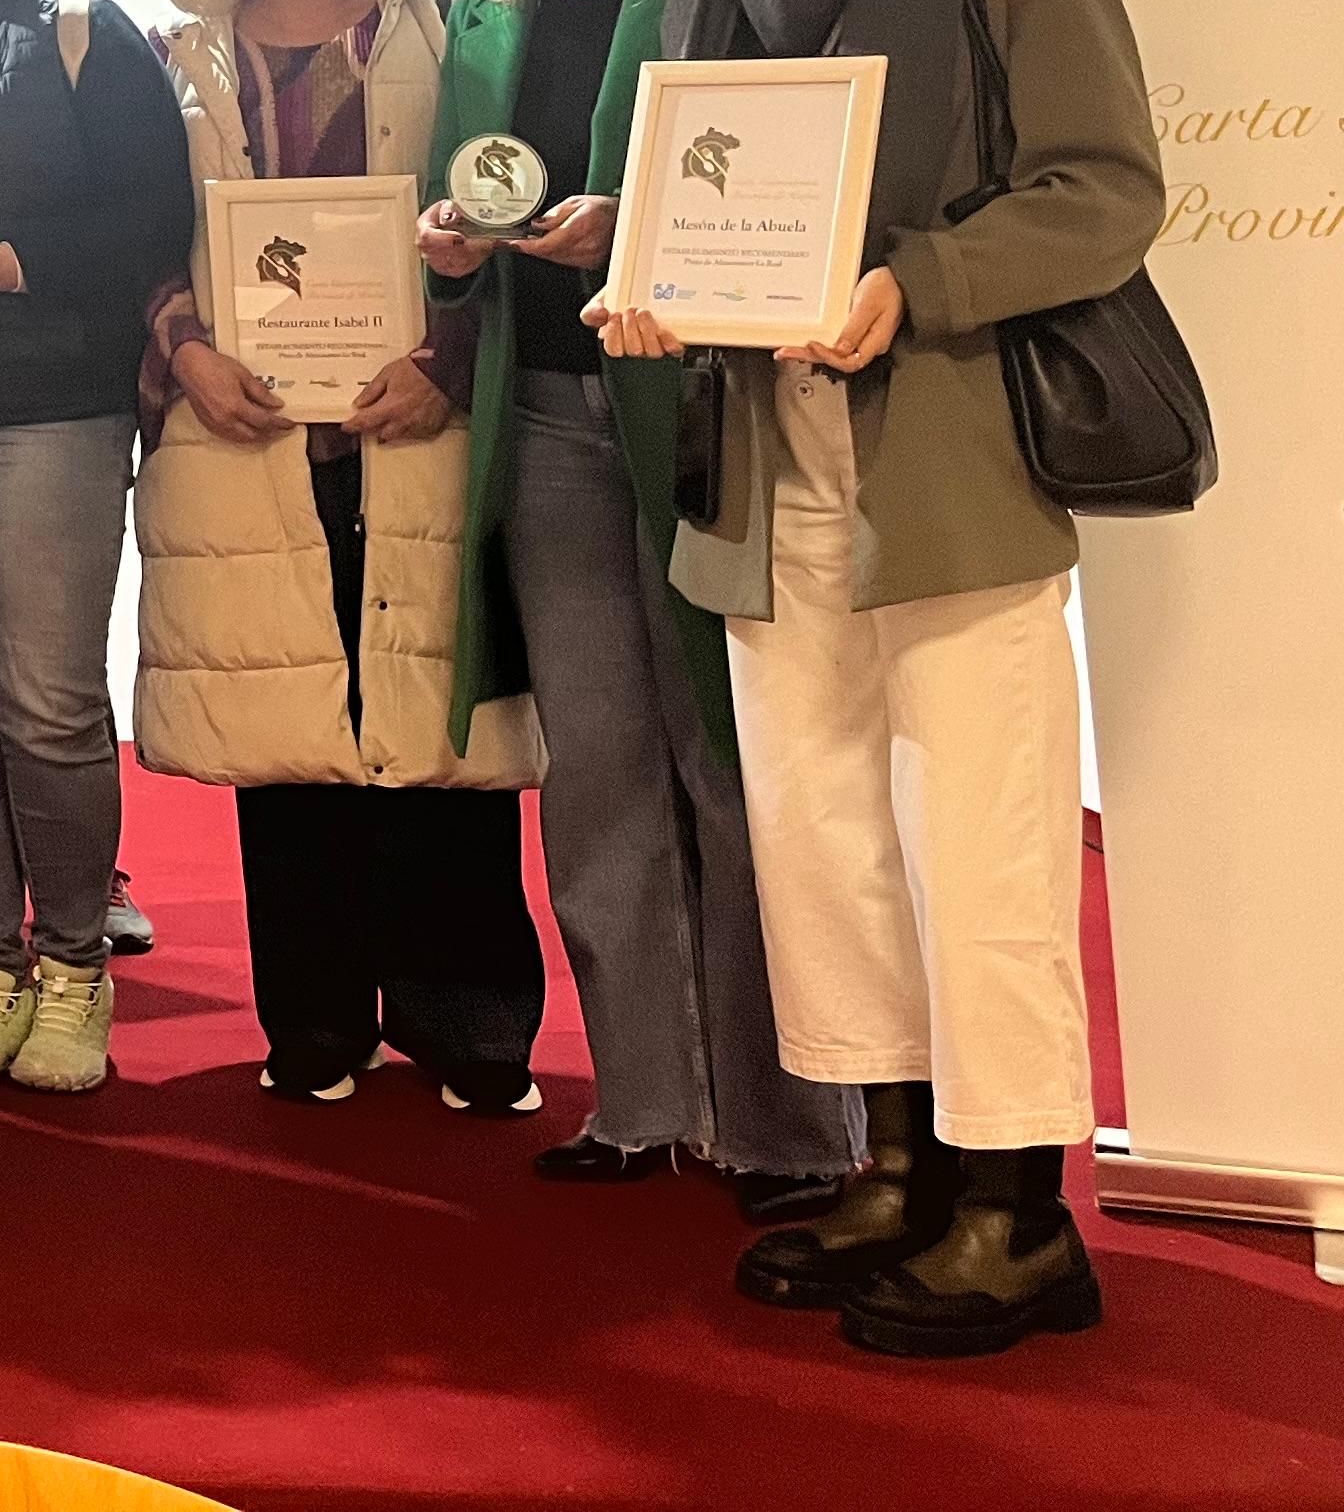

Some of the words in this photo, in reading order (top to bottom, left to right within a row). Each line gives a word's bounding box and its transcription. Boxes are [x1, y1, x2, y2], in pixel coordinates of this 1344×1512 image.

[672, 217, 716, 231] Mesón
[720, 218, 737, 232] de
[741, 218, 753, 232] la
[756, 219, 808, 233] Abuela
[258, 317, 331, 328] Restaurante
[334, 315, 369, 328] Isabel
